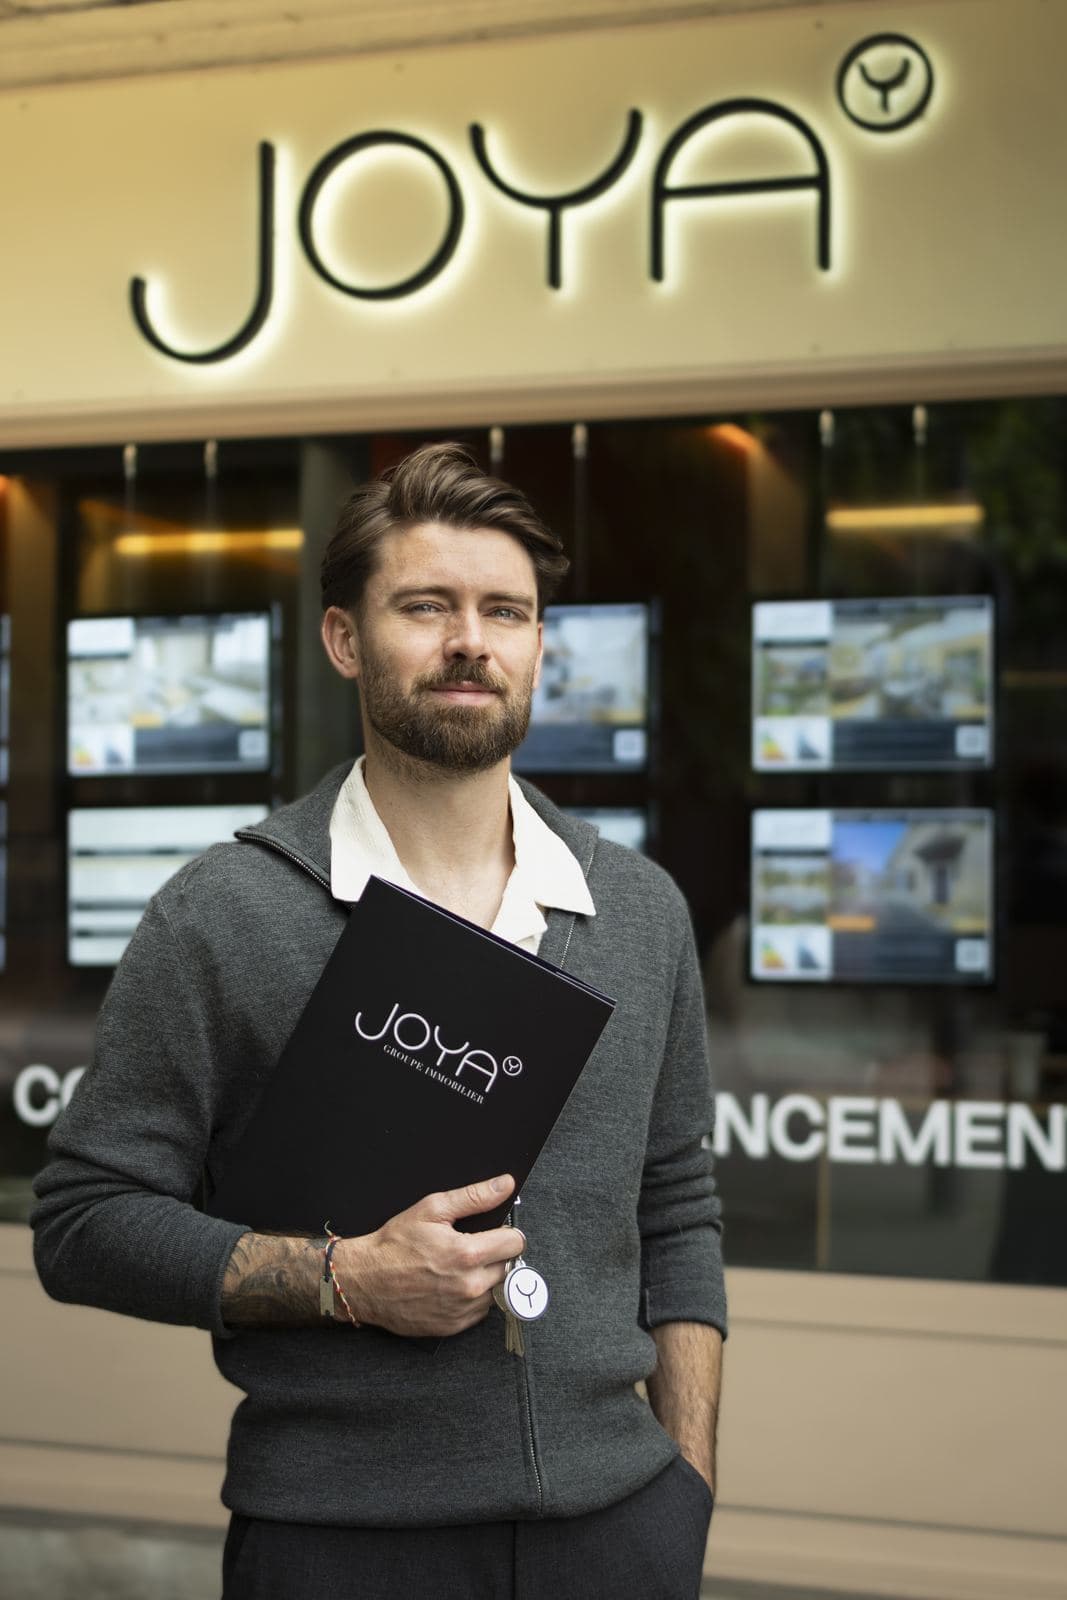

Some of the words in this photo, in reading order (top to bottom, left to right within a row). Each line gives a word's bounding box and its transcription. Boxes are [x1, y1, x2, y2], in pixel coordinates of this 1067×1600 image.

[130, 97, 831, 365] JOYA
[355, 1003, 498, 1092] JOYA
[383, 1044, 424, 1073] GROUPE
[425, 1066, 485, 1104] IMMOBILIER
[701, 1091, 1067, 1172] NCEMEN
